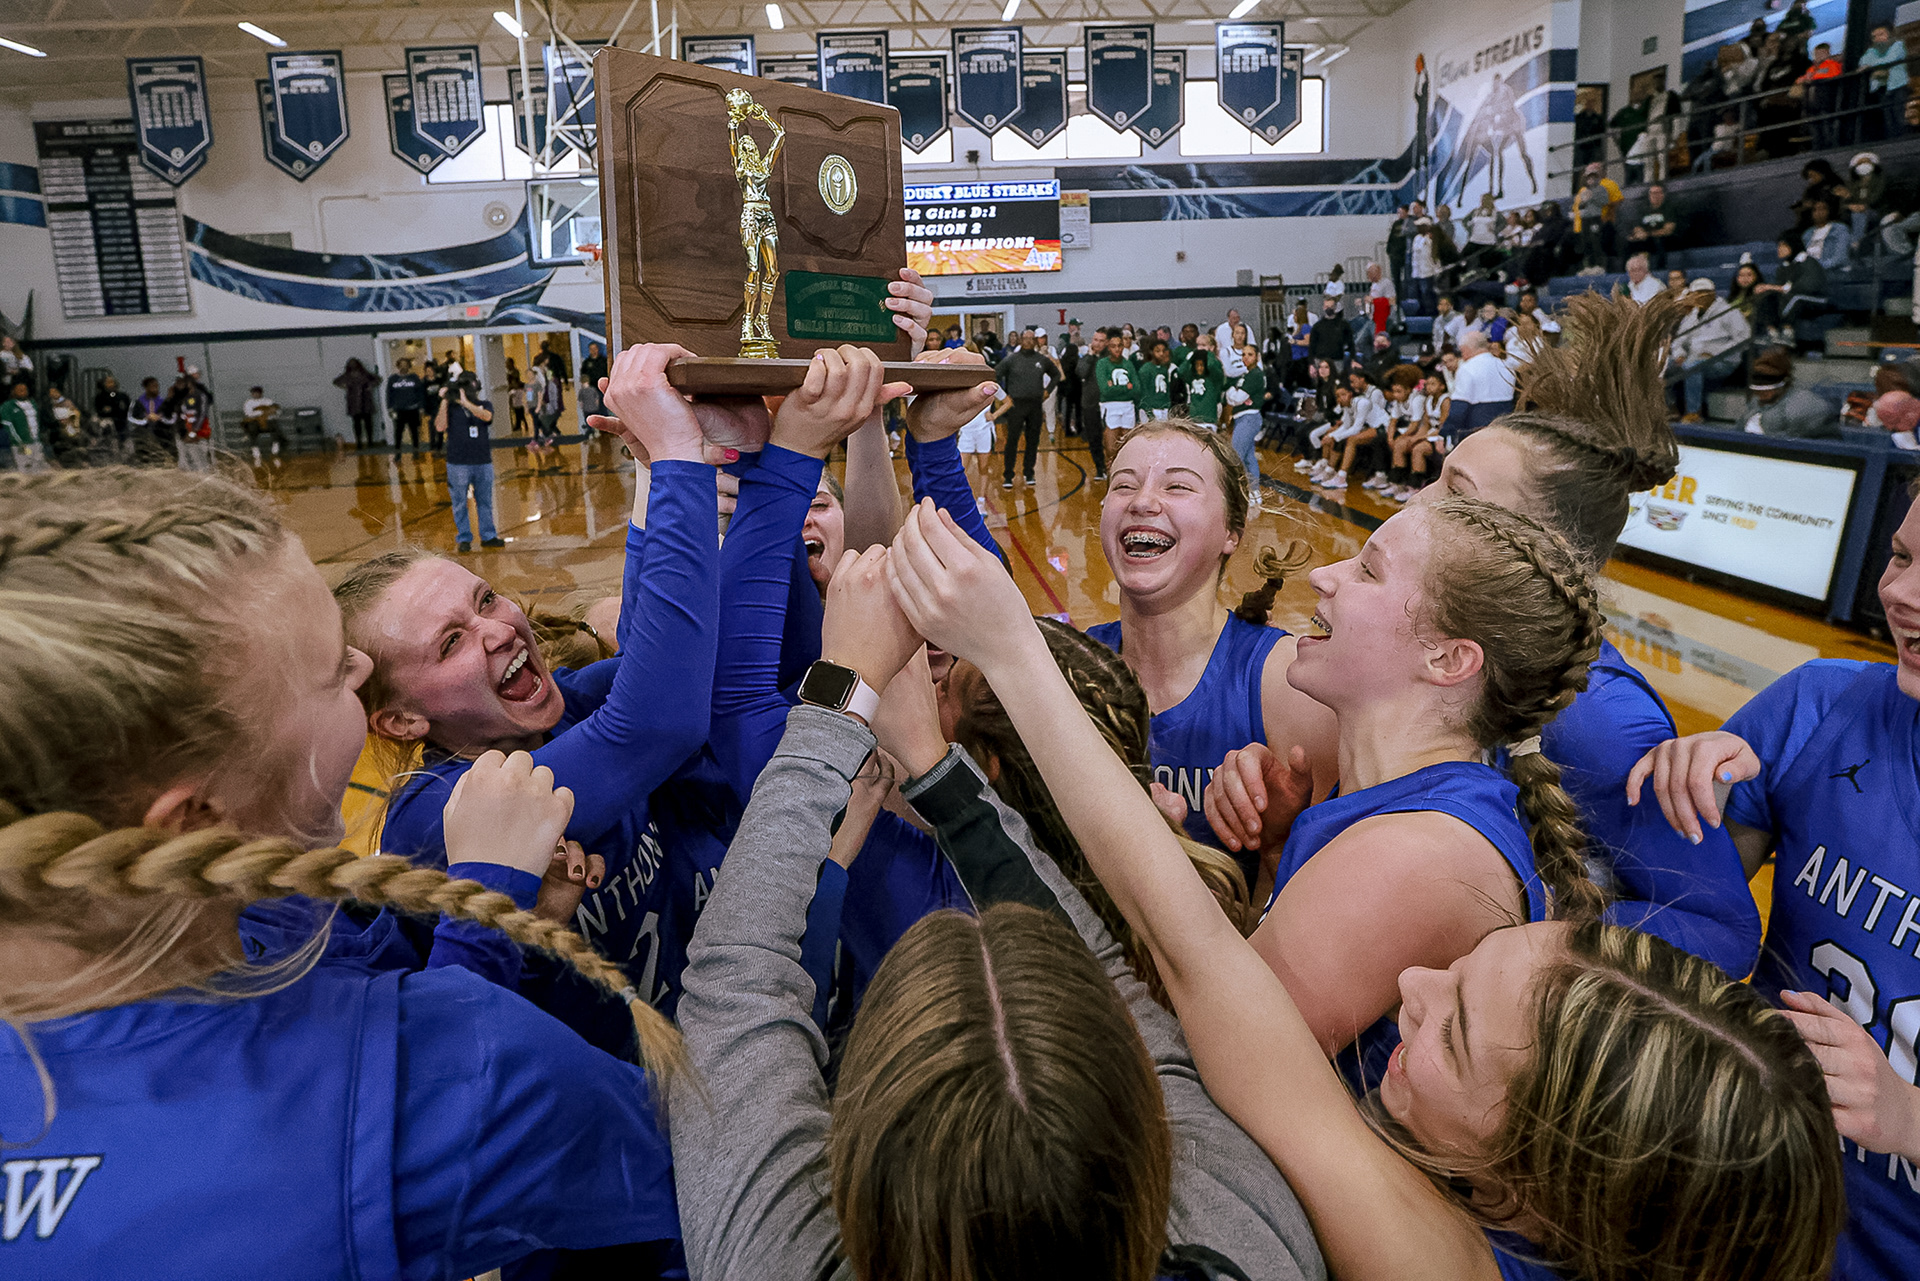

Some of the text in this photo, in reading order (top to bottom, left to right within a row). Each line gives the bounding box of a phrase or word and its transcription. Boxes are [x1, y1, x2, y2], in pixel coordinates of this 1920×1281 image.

[1474, 25, 1544, 73] STREAKS
[954, 185, 991, 199] BLUE
[993, 182, 1054, 198] STREAKS
[925, 206, 966, 220] Girls
[970, 205, 997, 219] D:1
[906, 222, 982, 237] REGION 2
[939, 237, 1035, 252] CHAMPIONS
[577, 822, 663, 944] NTHON
[0, 1156, 101, 1241] W
